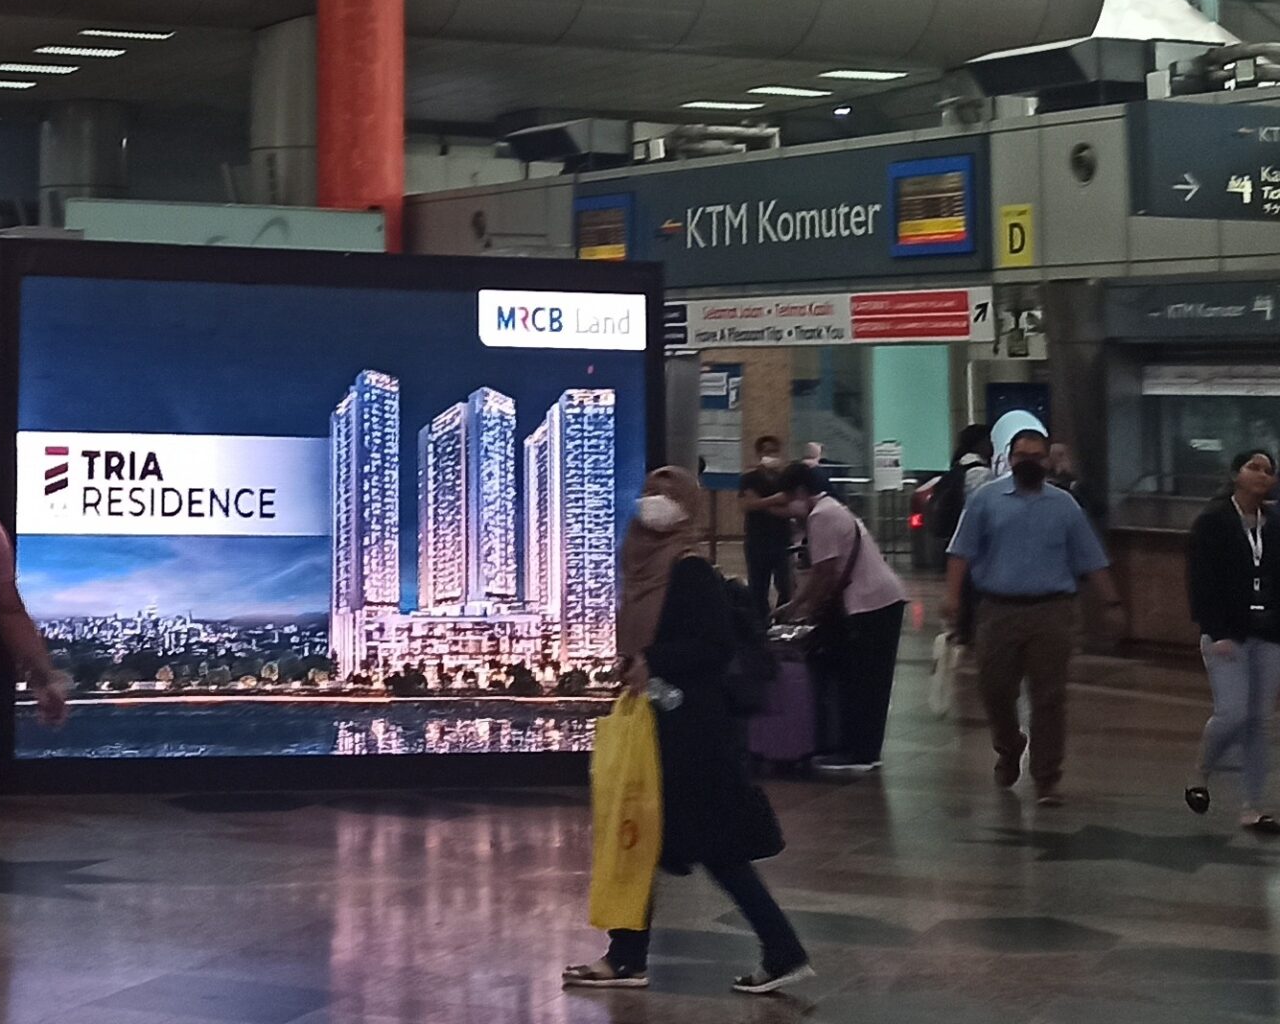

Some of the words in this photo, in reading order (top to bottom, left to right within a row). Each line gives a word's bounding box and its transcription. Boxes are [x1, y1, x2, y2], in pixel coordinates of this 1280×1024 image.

[686, 201, 748, 250] KTM
[757, 199, 882, 245] Komuter
[1009, 222, 1025, 254] D
[497, 305, 563, 333] MRCB
[576, 308, 631, 335] Land
[81, 450, 164, 481] TRIA
[82, 486, 277, 519] RESIDENCE
